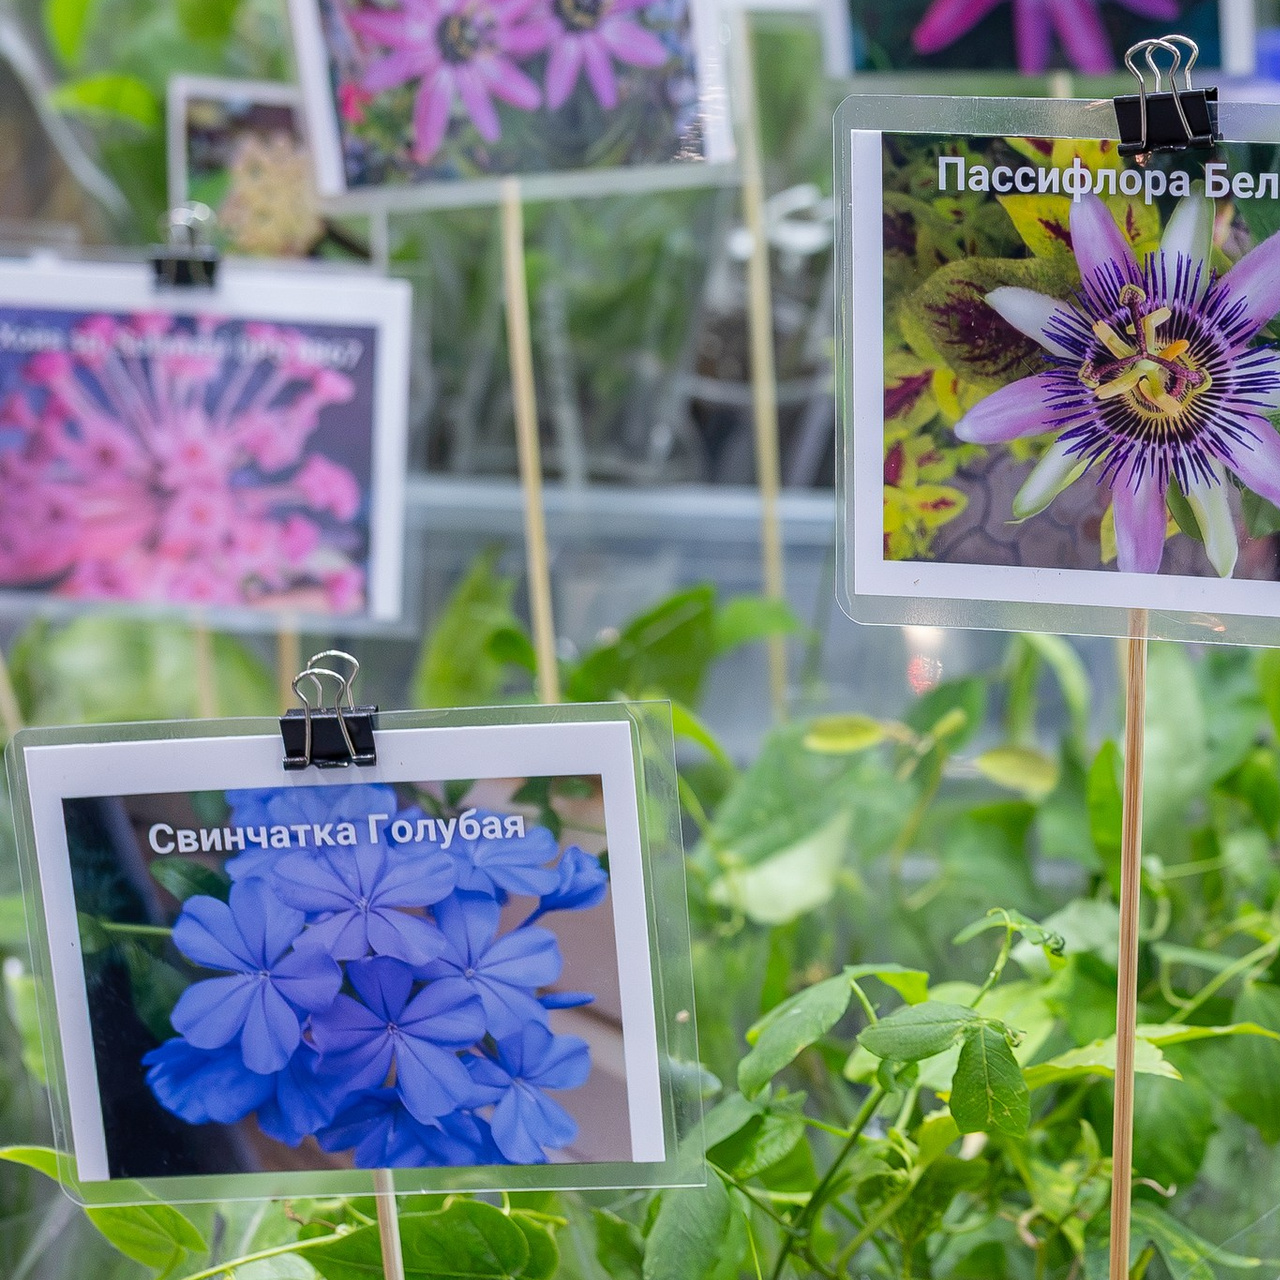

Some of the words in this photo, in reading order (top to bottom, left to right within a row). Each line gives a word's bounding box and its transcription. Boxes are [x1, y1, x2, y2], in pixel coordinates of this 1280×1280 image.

[937, 155, 1191, 205] Пассифлора
[148, 819, 358, 856] Свинчатка
[366, 811, 527, 850] Голубая
